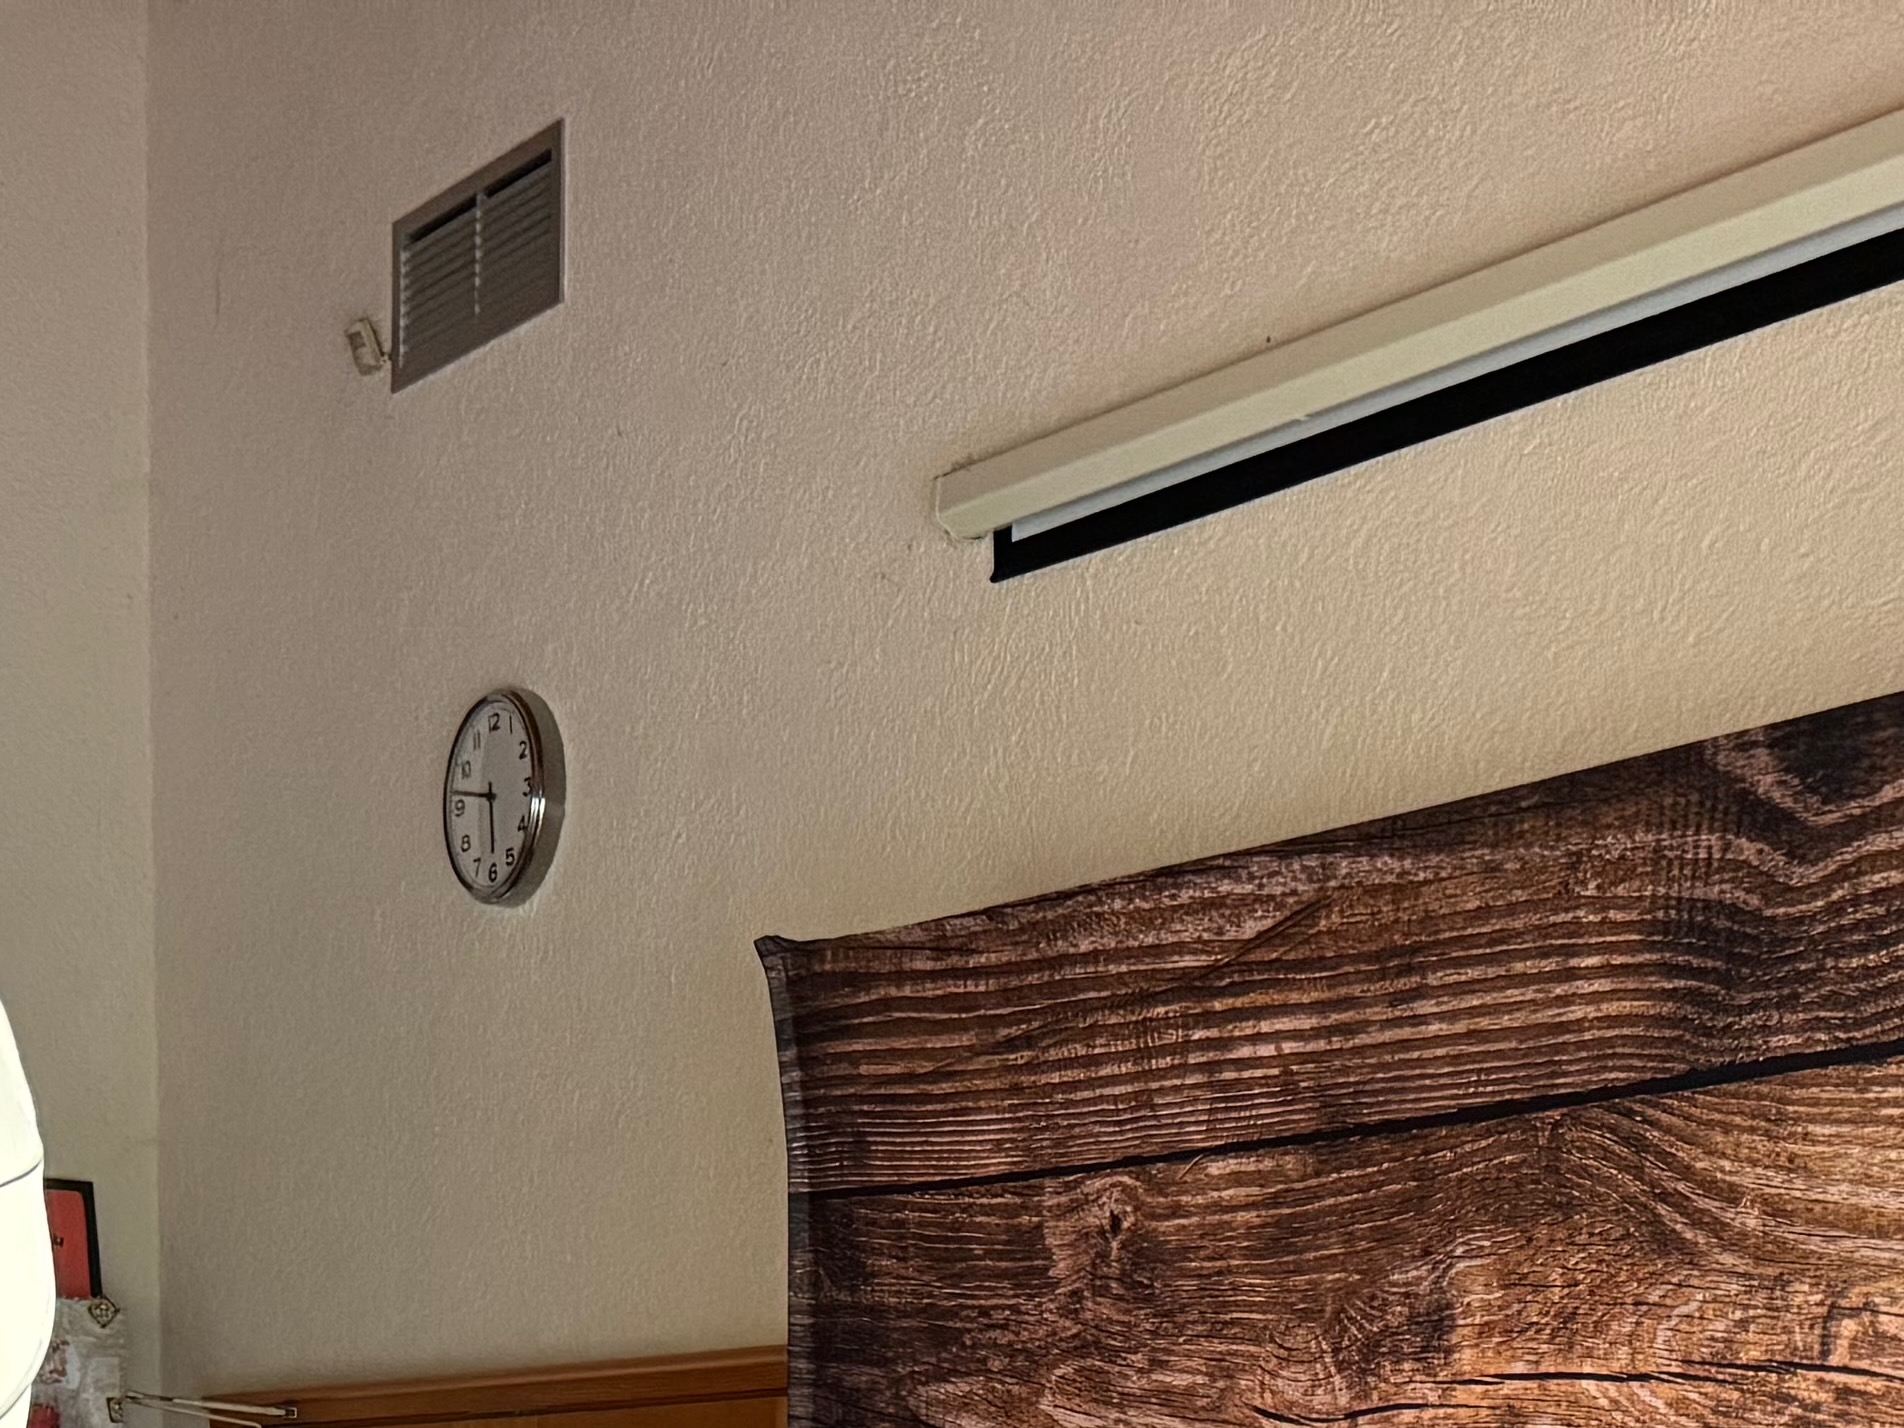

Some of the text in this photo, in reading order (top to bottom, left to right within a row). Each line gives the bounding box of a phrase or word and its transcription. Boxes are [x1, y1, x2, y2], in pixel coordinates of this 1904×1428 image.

[487, 712, 501, 733] 12
[472, 731, 481, 751] 11
[518, 740, 528, 760] 2
[461, 760, 472, 780] 10
[522, 776, 533, 798] 3
[454, 799, 466, 818] 9
[517, 815, 528, 832] 4
[460, 834, 472, 853] 8
[505, 847, 516, 867] 5
[472, 857, 482, 879] 7
[487, 862, 498, 883] 6
